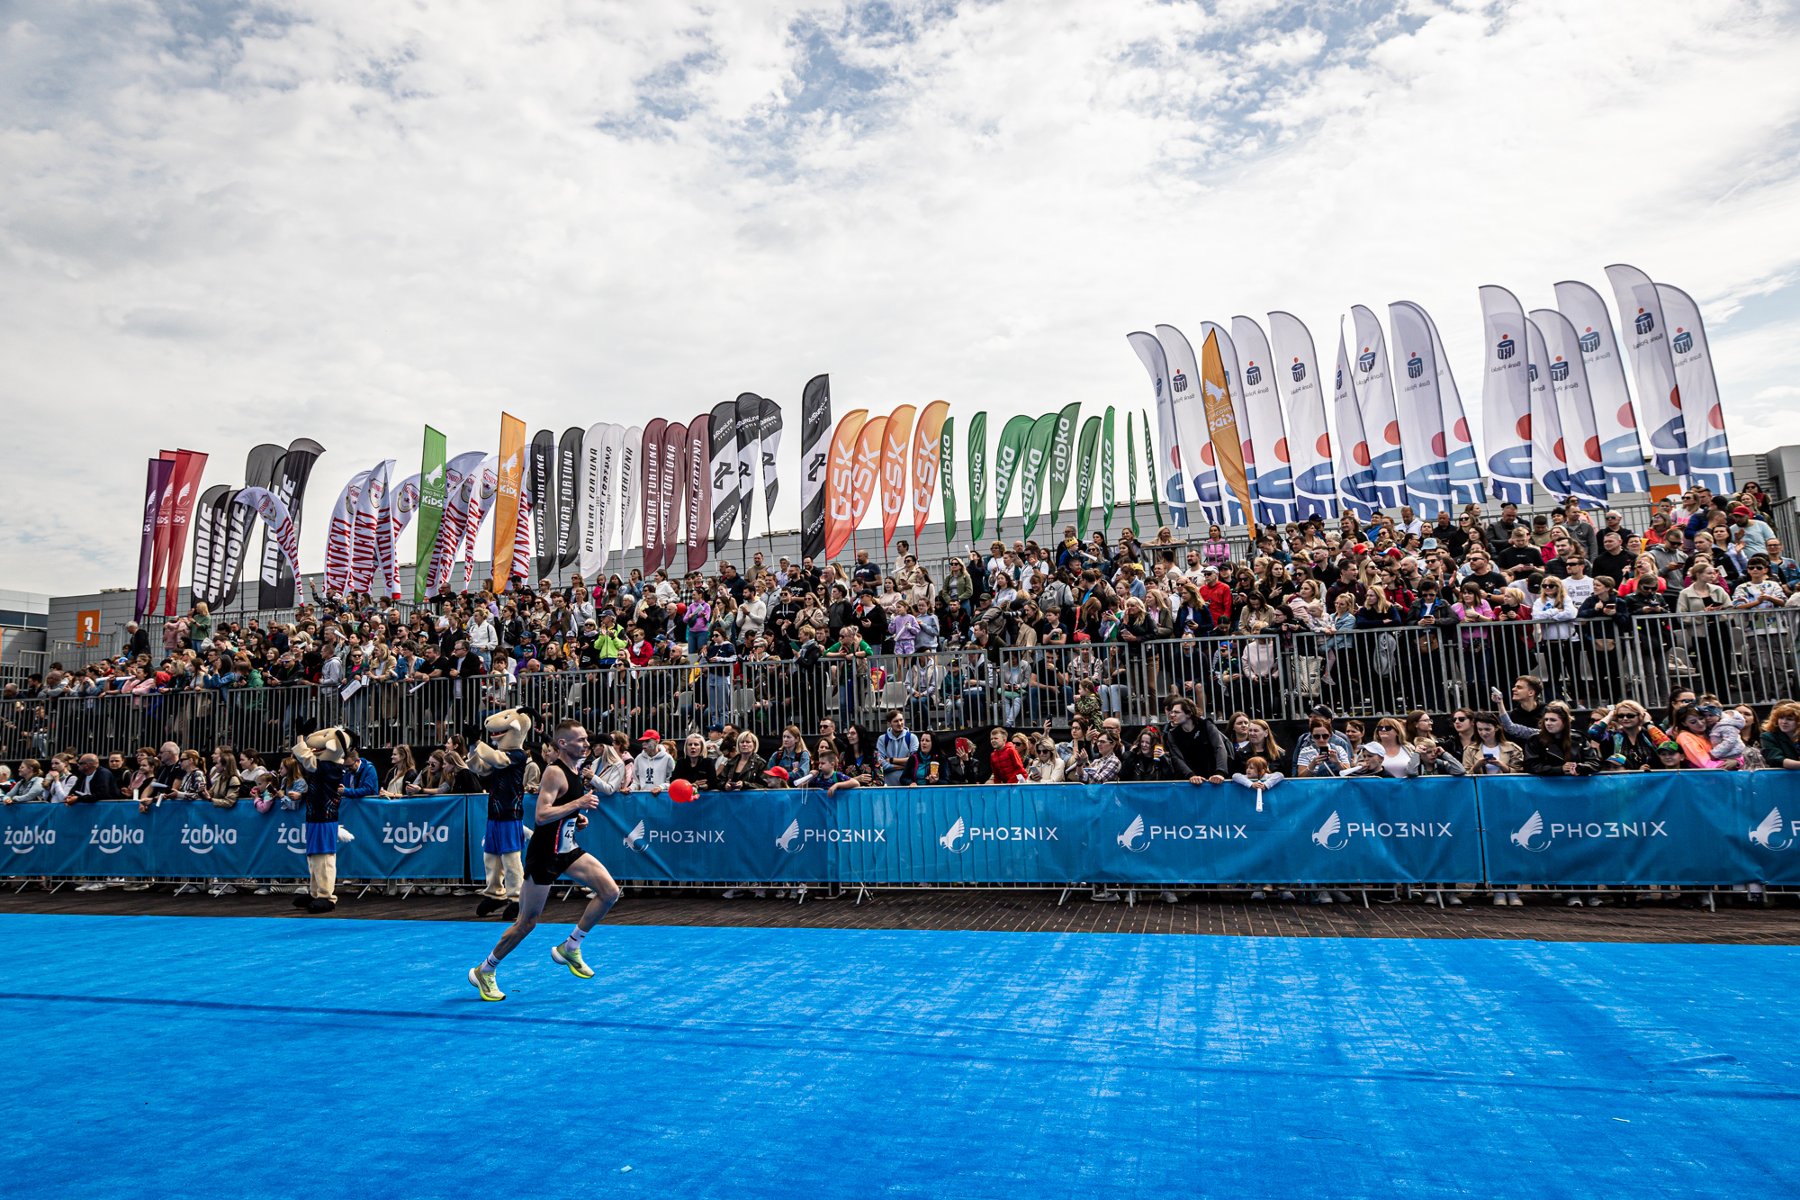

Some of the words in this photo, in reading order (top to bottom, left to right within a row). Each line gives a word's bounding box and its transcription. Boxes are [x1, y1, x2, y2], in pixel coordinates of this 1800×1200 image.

[588, 448, 598, 499] FORTUNA
[648, 442, 657, 494] FORTUNA
[664, 444, 676, 496] FORTUNA
[692, 439, 702, 491] FORTUNA
[884, 433, 906, 515] GSK
[914, 430, 939, 514] GSK
[943, 434, 952, 500] żabka
[1052, 417, 1070, 484] żabka
[537, 454, 545, 503] FORTUNA
[561, 451, 573, 502] FORTUNA
[831, 439, 854, 522] GSK
[853, 435, 880, 518] GSK
[1079, 455, 1090, 507] żabka
[537, 508, 545, 557] BROWAR
[558, 505, 571, 555] BROWAR
[586, 504, 594, 553] BROWAR
[646, 500, 657, 549] BROWAR
[689, 497, 698, 547] BROWAR
[4, 826, 56, 845] żabka
[89, 825, 144, 844] żabka
[180, 824, 237, 844] żabka
[382, 822, 449, 844] żabka
[649, 829, 725, 843] PHO3NIX
[803, 829, 886, 843] PHO3NIX
[970, 827, 1058, 841] PHO3NIX
[1150, 824, 1247, 840] PHO3NIX
[1347, 822, 1452, 838] PHO3NIX
[1551, 820, 1667, 838] PHO3NIX
